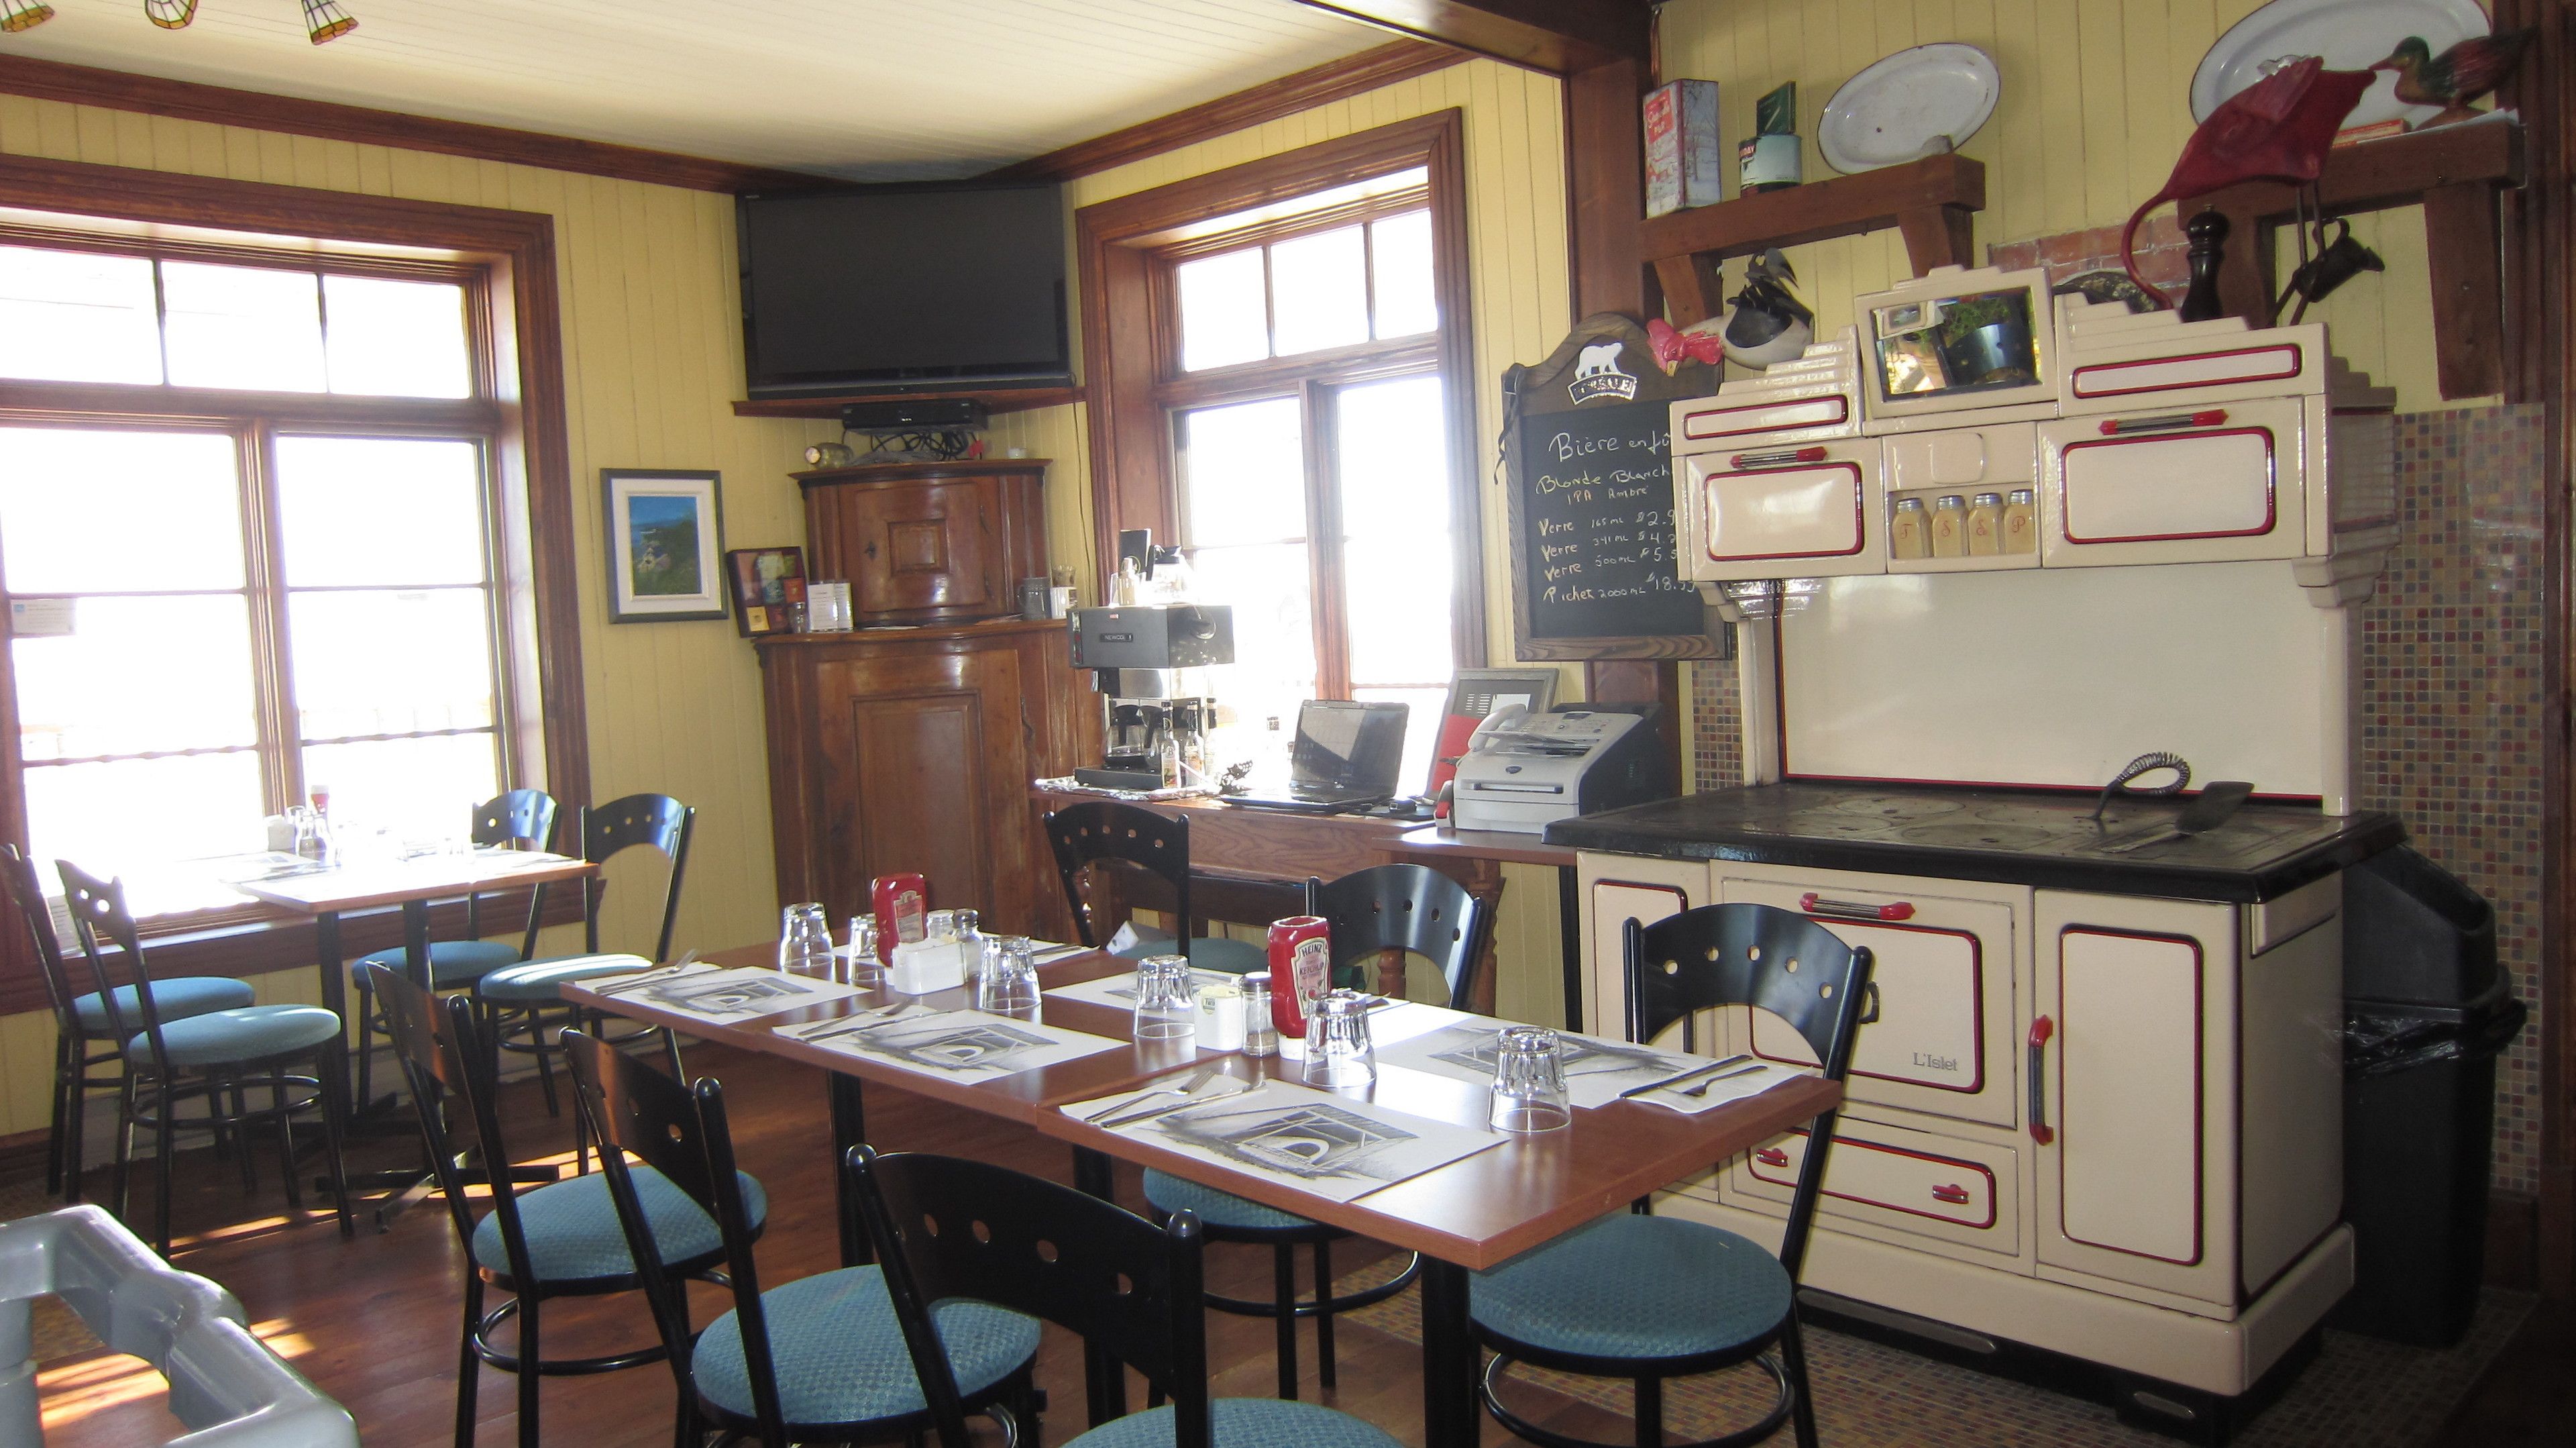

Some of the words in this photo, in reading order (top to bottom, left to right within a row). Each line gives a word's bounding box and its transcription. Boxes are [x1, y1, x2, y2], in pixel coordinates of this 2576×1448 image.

[1548, 432, 1619, 462] Bière
[1536, 470, 1601, 495] Blonde
[1538, 518, 1574, 536] Verre
[1541, 544, 1578, 562] Verre
[1544, 563, 1582, 582] Verre
[1598, 588, 1627, 599] 2000
[1301, 944, 1322, 957] HEINZ
[1913, 1052, 1958, 1072] L'Islet
